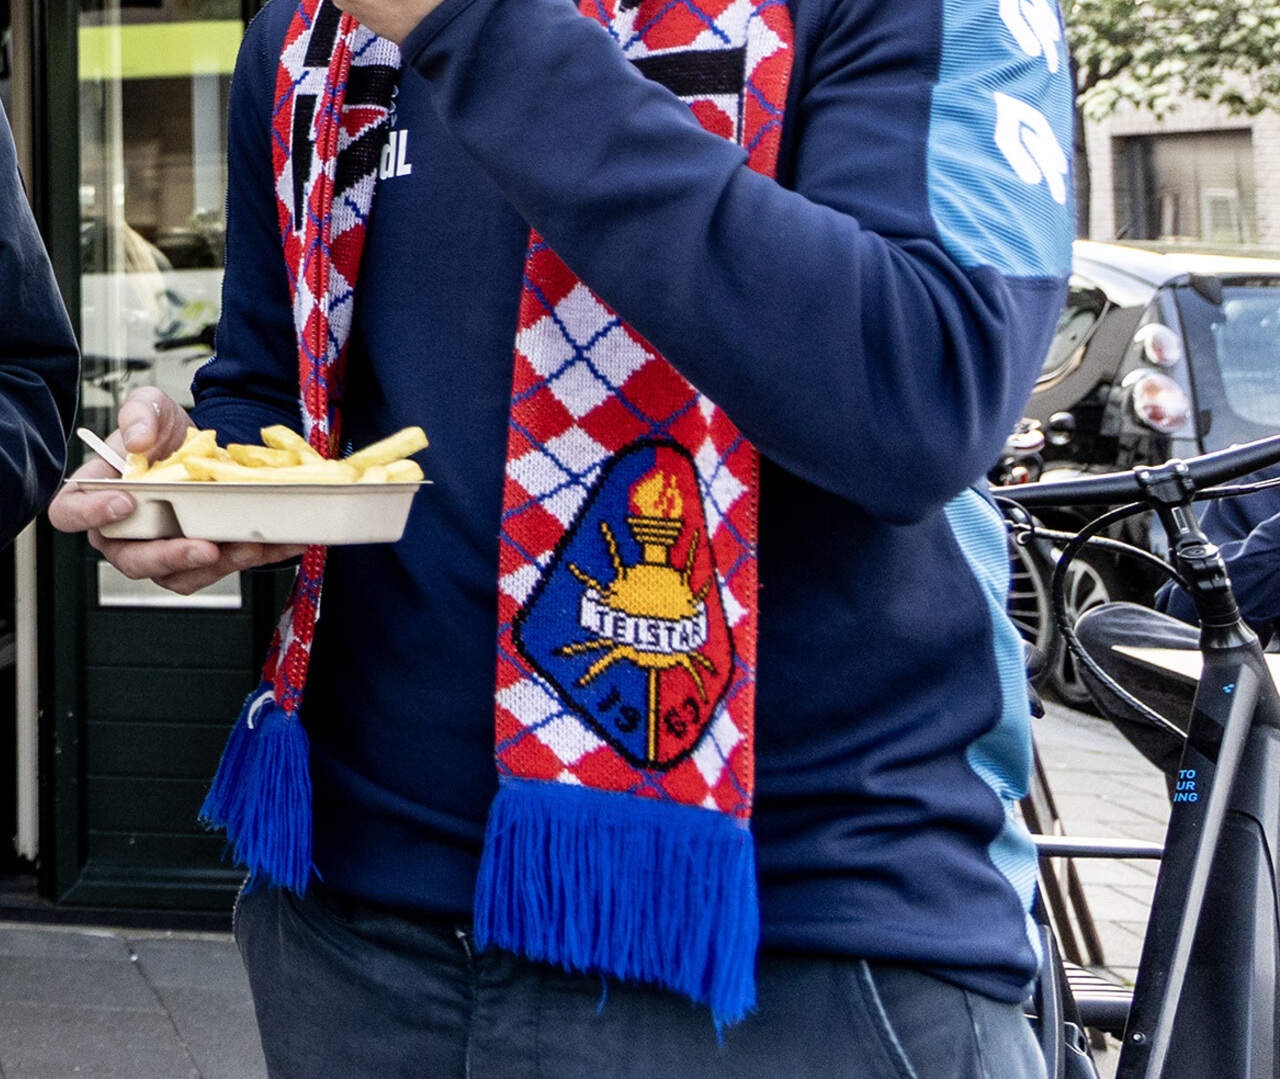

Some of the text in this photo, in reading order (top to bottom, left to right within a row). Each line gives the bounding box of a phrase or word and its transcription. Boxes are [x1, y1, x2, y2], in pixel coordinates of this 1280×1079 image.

[595, 609, 707, 647] TELSTAR
[1178, 769, 1196, 779] TO
[1176, 781, 1196, 791] UR
[1173, 793, 1198, 802] ING
